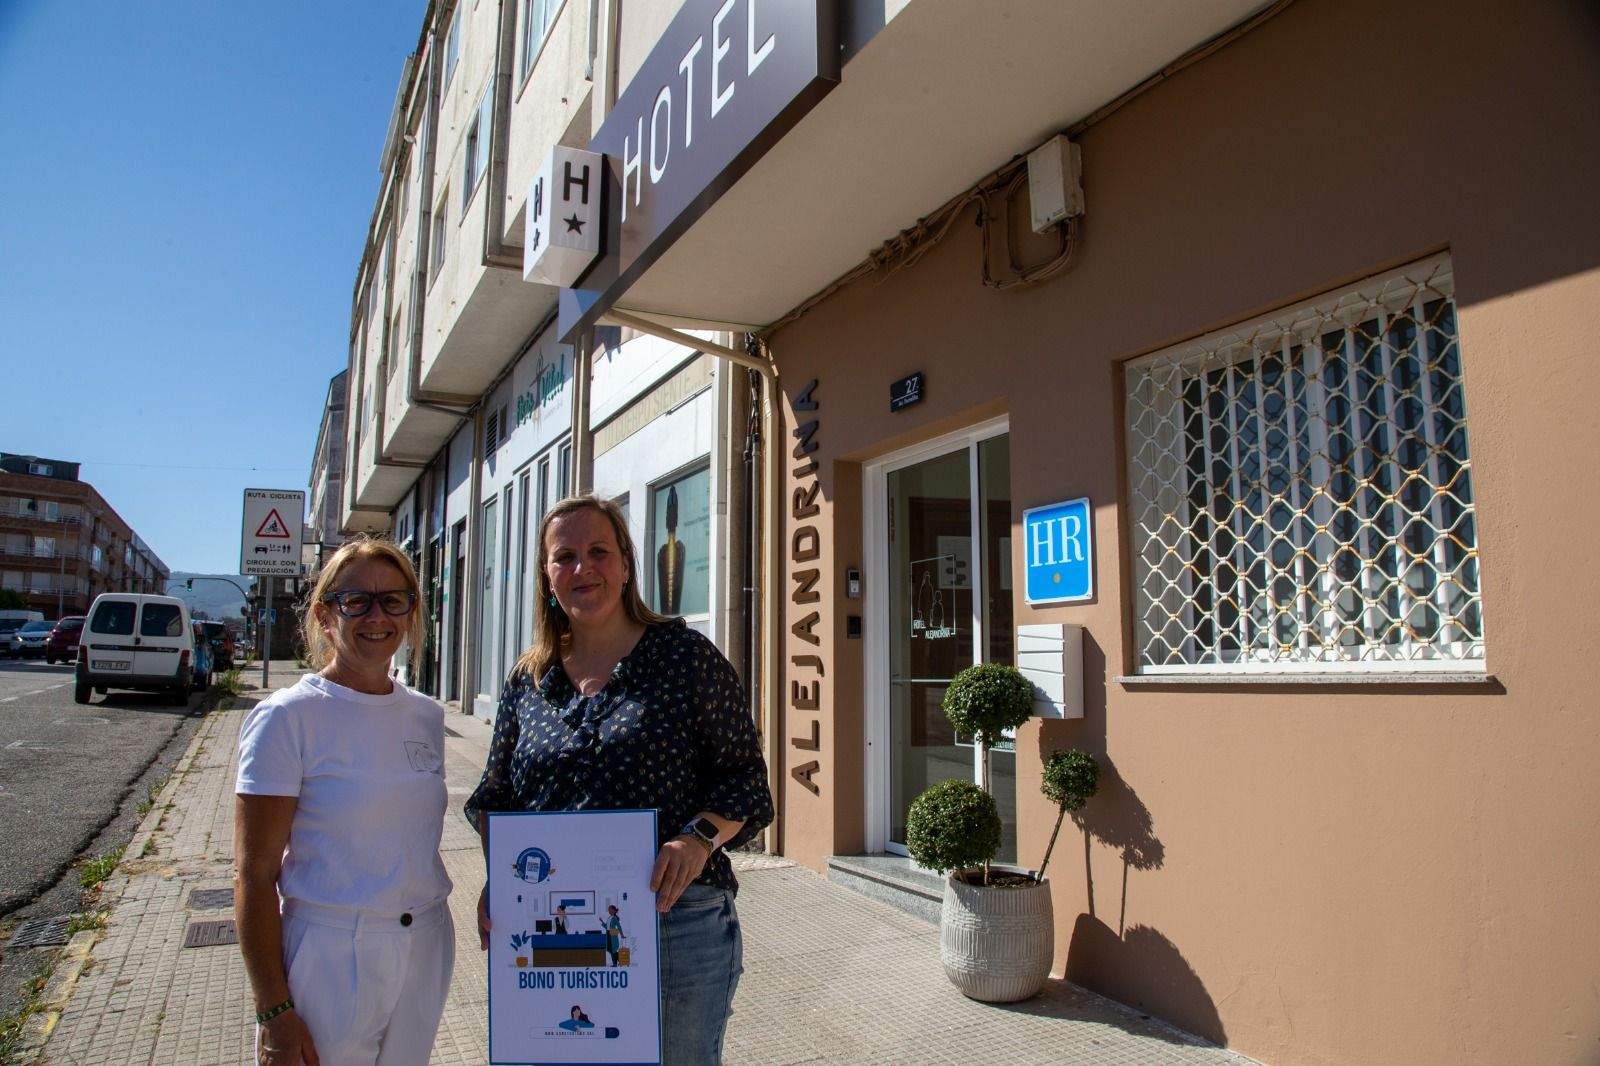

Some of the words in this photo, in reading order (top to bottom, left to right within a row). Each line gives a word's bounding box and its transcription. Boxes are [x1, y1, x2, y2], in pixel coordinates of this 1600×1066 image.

[622, 0, 775, 224] HOTEL
[533, 176, 544, 223] H
[563, 161, 590, 205] H
[905, 376, 918, 394] 27
[1029, 515, 1085, 567] HR
[247, 566, 294, 574] PRECAUCIÓN
[791, 378, 826, 797] ALEJANDRINA
[519, 971, 555, 989] BONO
[558, 967, 628, 989] TURÍSTICO
